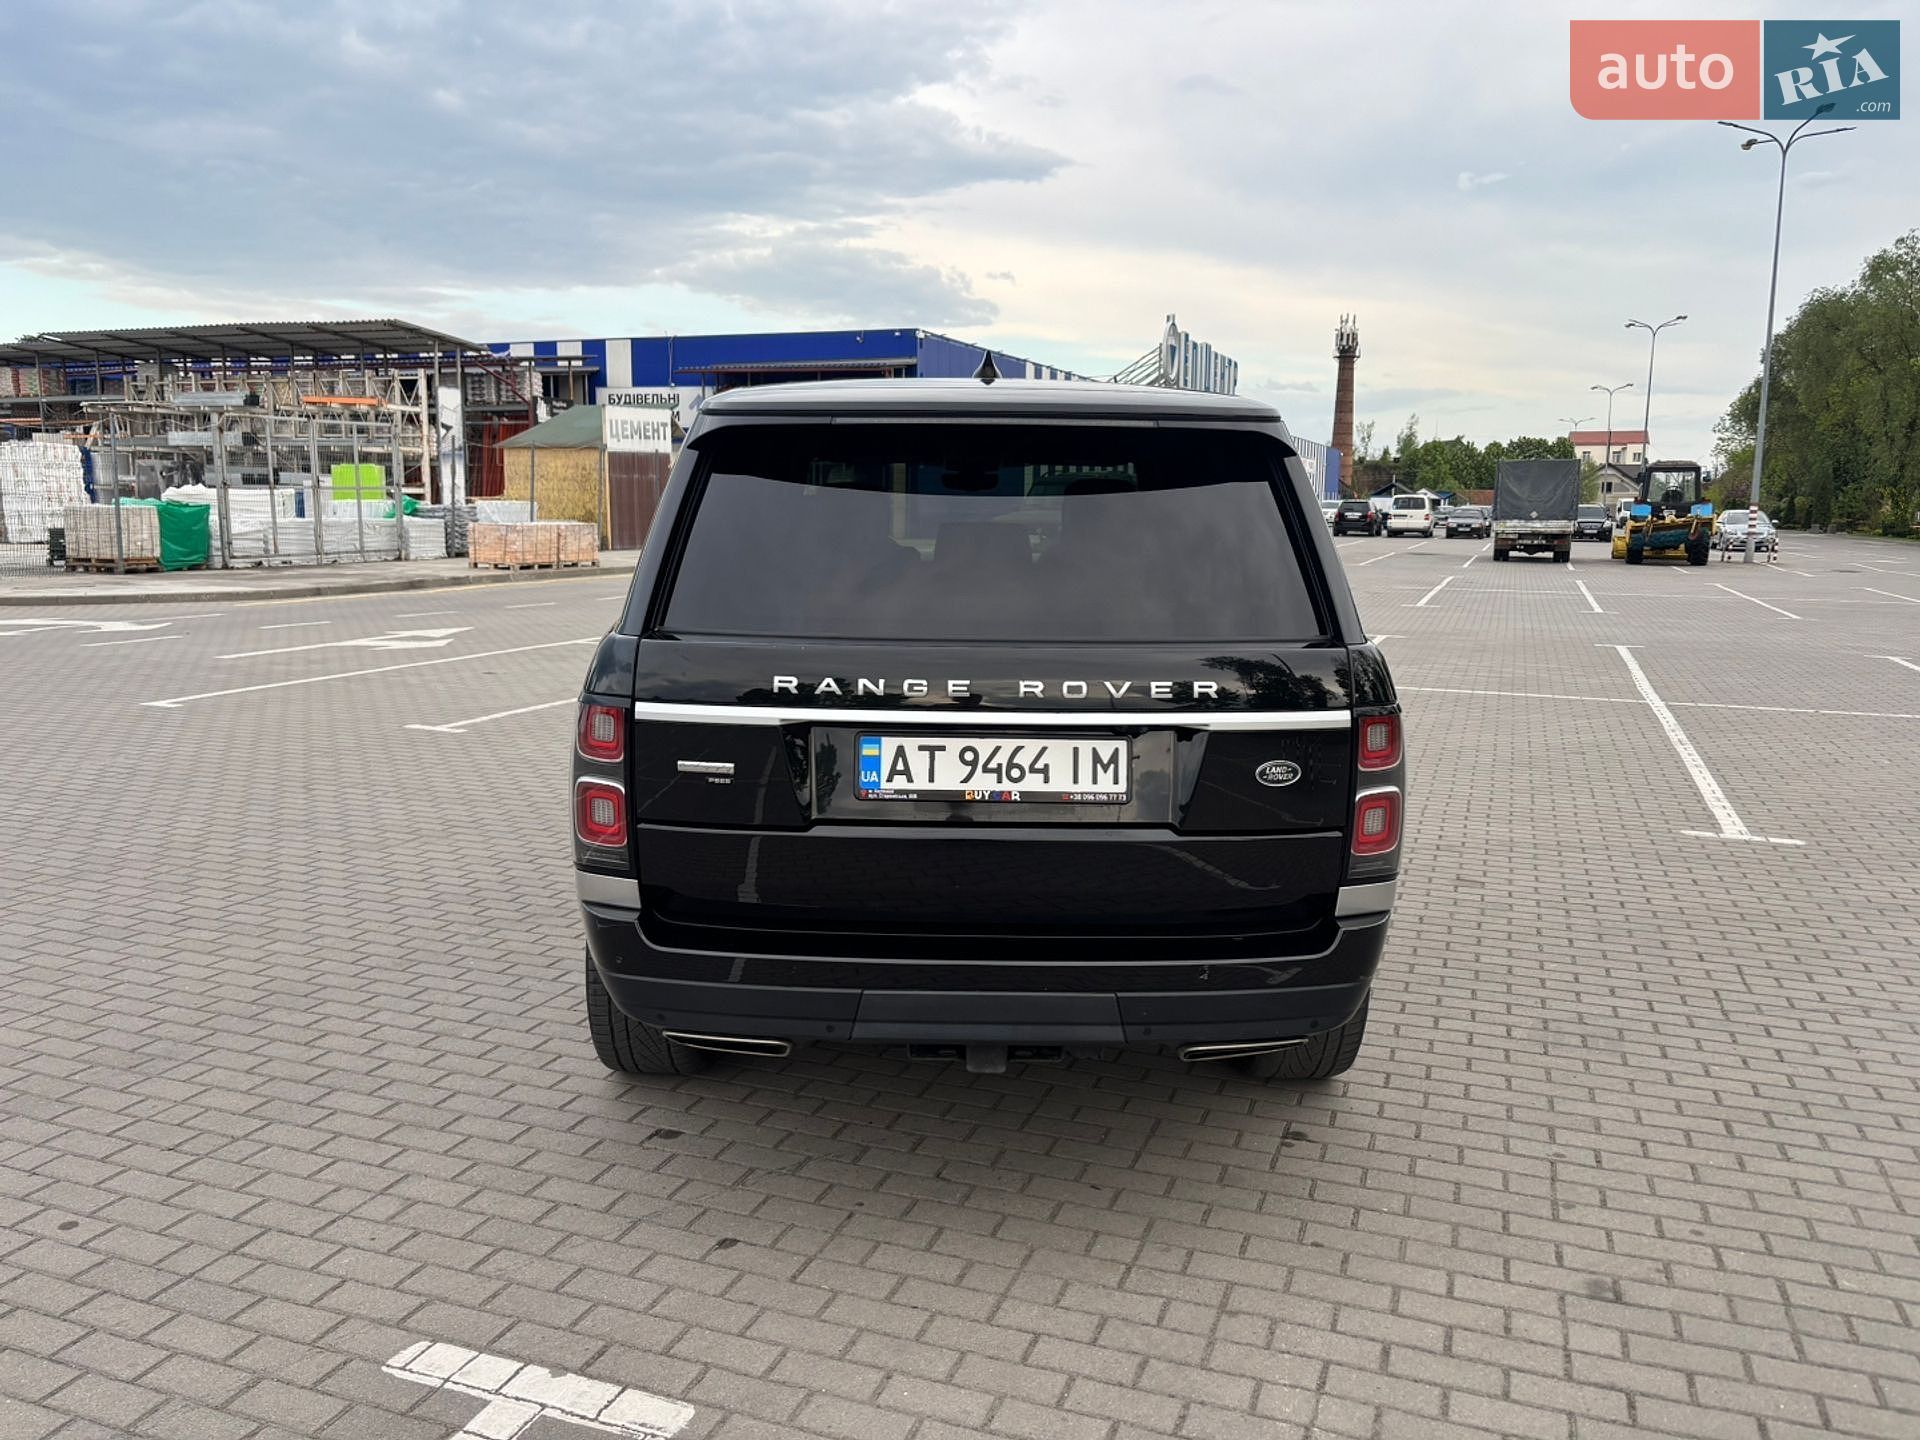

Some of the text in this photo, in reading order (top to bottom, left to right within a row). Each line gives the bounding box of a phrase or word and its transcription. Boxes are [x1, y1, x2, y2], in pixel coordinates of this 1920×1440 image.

[608, 393, 680, 406] БУДІВЕЛЬНІ
[609, 418, 668, 442] ЦЕМЕНТ
[772, 675, 1219, 699] RANGE ROVER
[886, 744, 946, 784] AT
[958, 745, 1049, 784] 9464
[861, 771, 878, 783] UA
